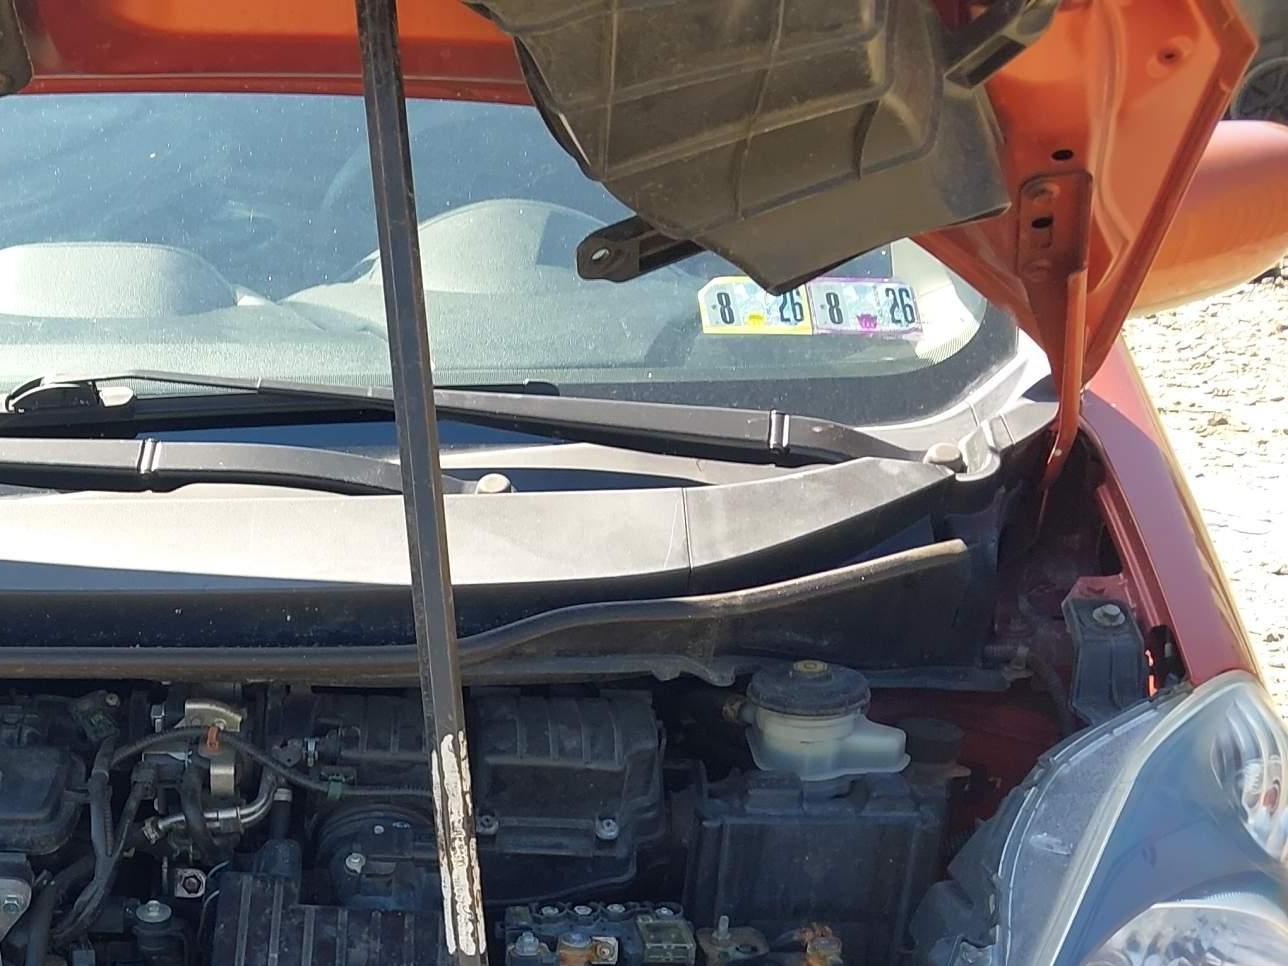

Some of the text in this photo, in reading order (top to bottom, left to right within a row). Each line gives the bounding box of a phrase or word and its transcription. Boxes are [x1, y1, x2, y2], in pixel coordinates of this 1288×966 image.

[717, 289, 804, 324] 8 26
[825, 287, 915, 324] 8 26
